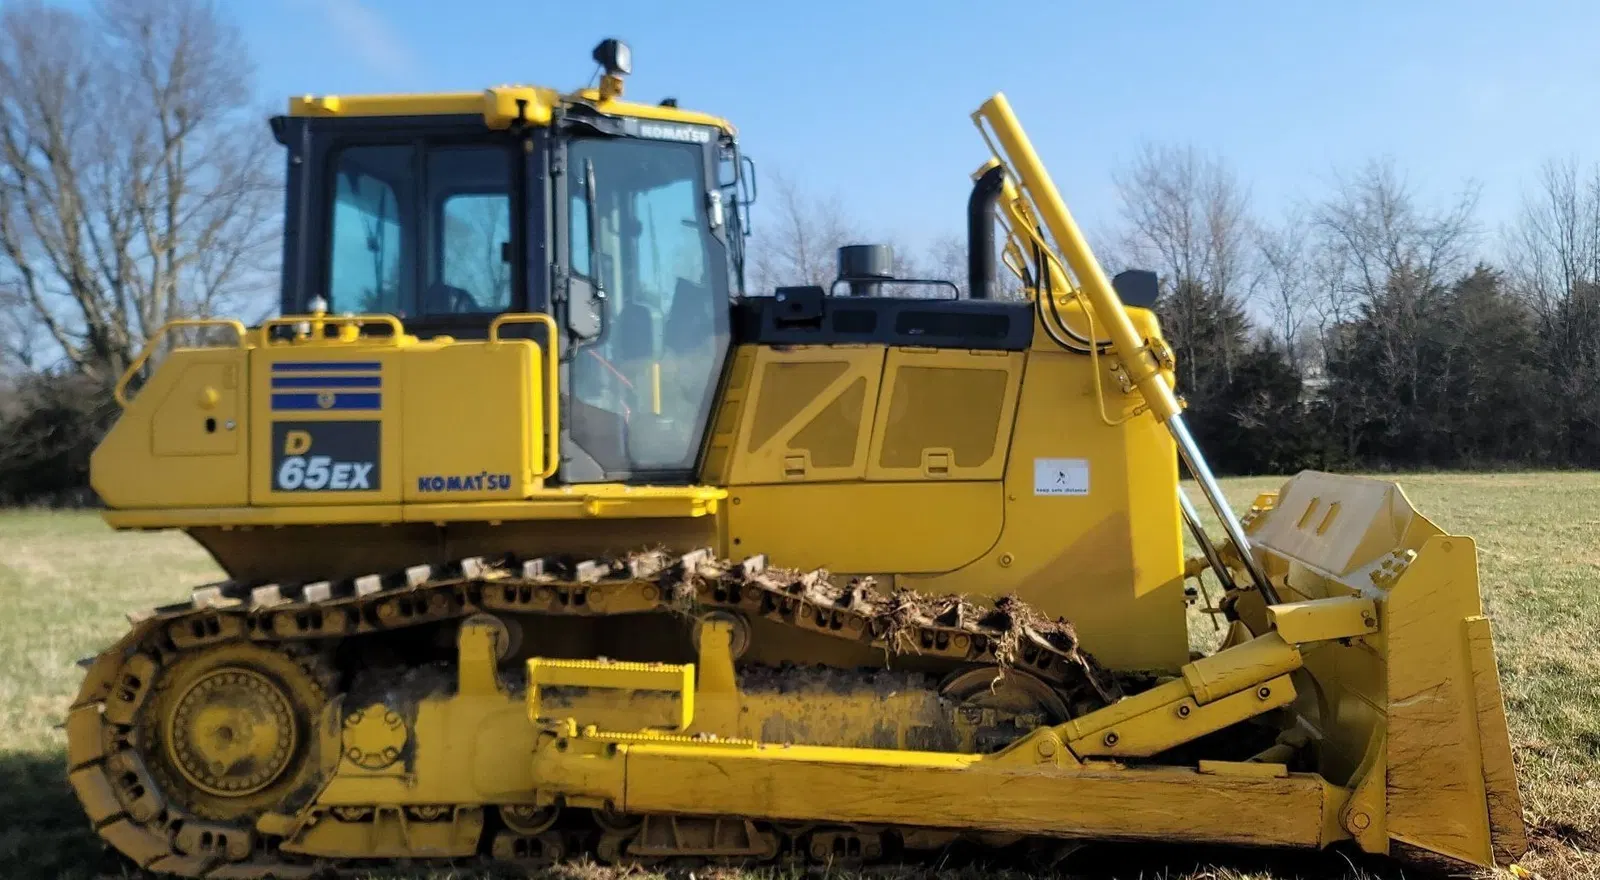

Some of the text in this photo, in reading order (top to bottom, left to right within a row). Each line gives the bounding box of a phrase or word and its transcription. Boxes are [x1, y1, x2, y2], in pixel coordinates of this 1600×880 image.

[641, 125, 709, 143] KOMATSU
[285, 430, 313, 456] D
[279, 456, 373, 490] 65EX
[418, 471, 511, 492] KOMATSU
